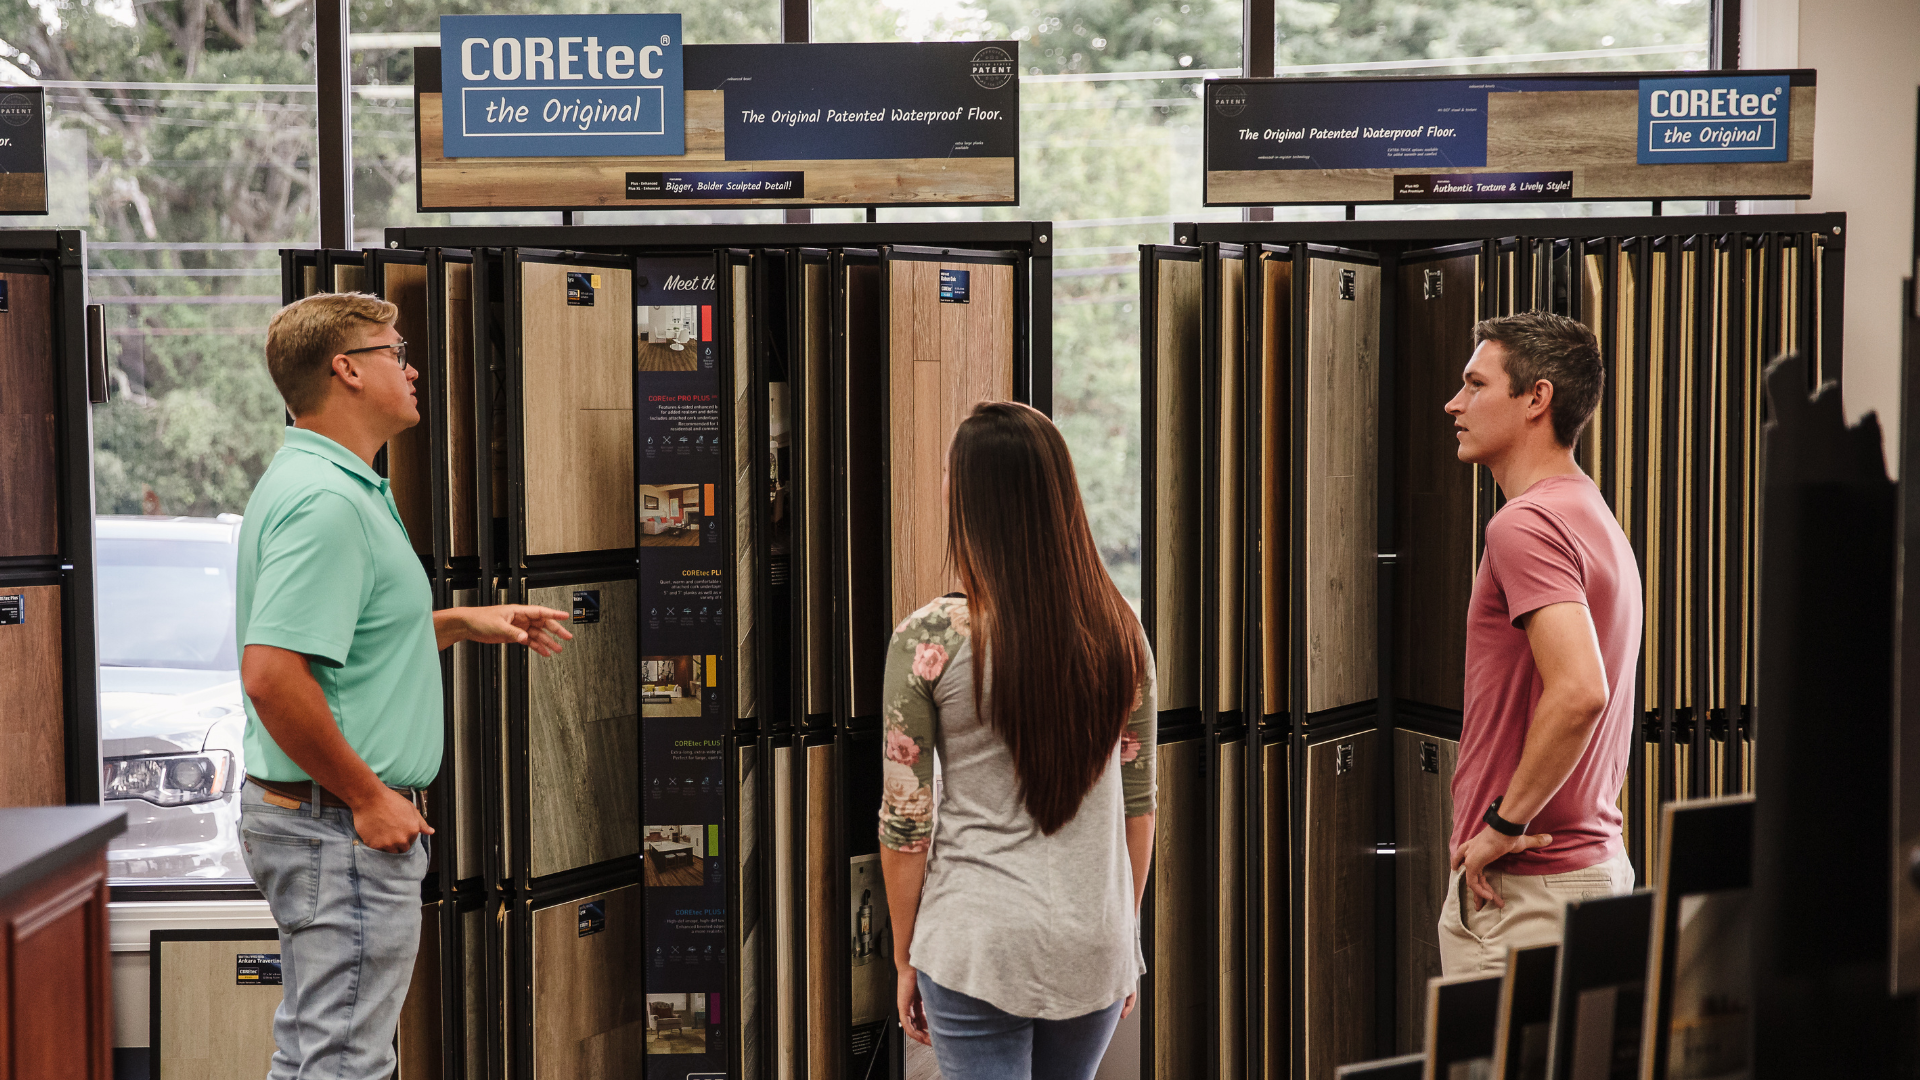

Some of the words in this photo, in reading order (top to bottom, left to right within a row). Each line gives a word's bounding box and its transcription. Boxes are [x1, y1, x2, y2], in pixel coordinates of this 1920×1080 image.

[486, 96, 530, 123] the
[542, 96, 641, 131] Original
[742, 110, 765, 123] The
[772, 109, 820, 127] Original
[827, 108, 886, 122] Patented
[891, 106, 963, 125] Waterproof
[968, 107, 1003, 120] Floor.
[1239, 128, 1259, 140] The
[1264, 128, 1305, 143] Original
[1309, 127, 1359, 139] Patented
[1363, 126, 1424, 141] Waterproof
[1427, 125, 1457, 137] Floor.
[1664, 126, 1692, 143] the
[1699, 124, 1761, 147] Original
[666, 182, 694, 193] Bigger,
[697, 181, 723, 190] Bolder
[726, 181, 761, 192] Sculpted
[765, 181, 792, 190] Detail!
[1433, 184, 1473, 193] Authentic
[1476, 183, 1506, 192] Texture
[1509, 183, 1516, 191] &
[1520, 182, 1543, 193] Lively
[1546, 180, 1571, 192] Style!
[663, 274, 699, 290] Meet
